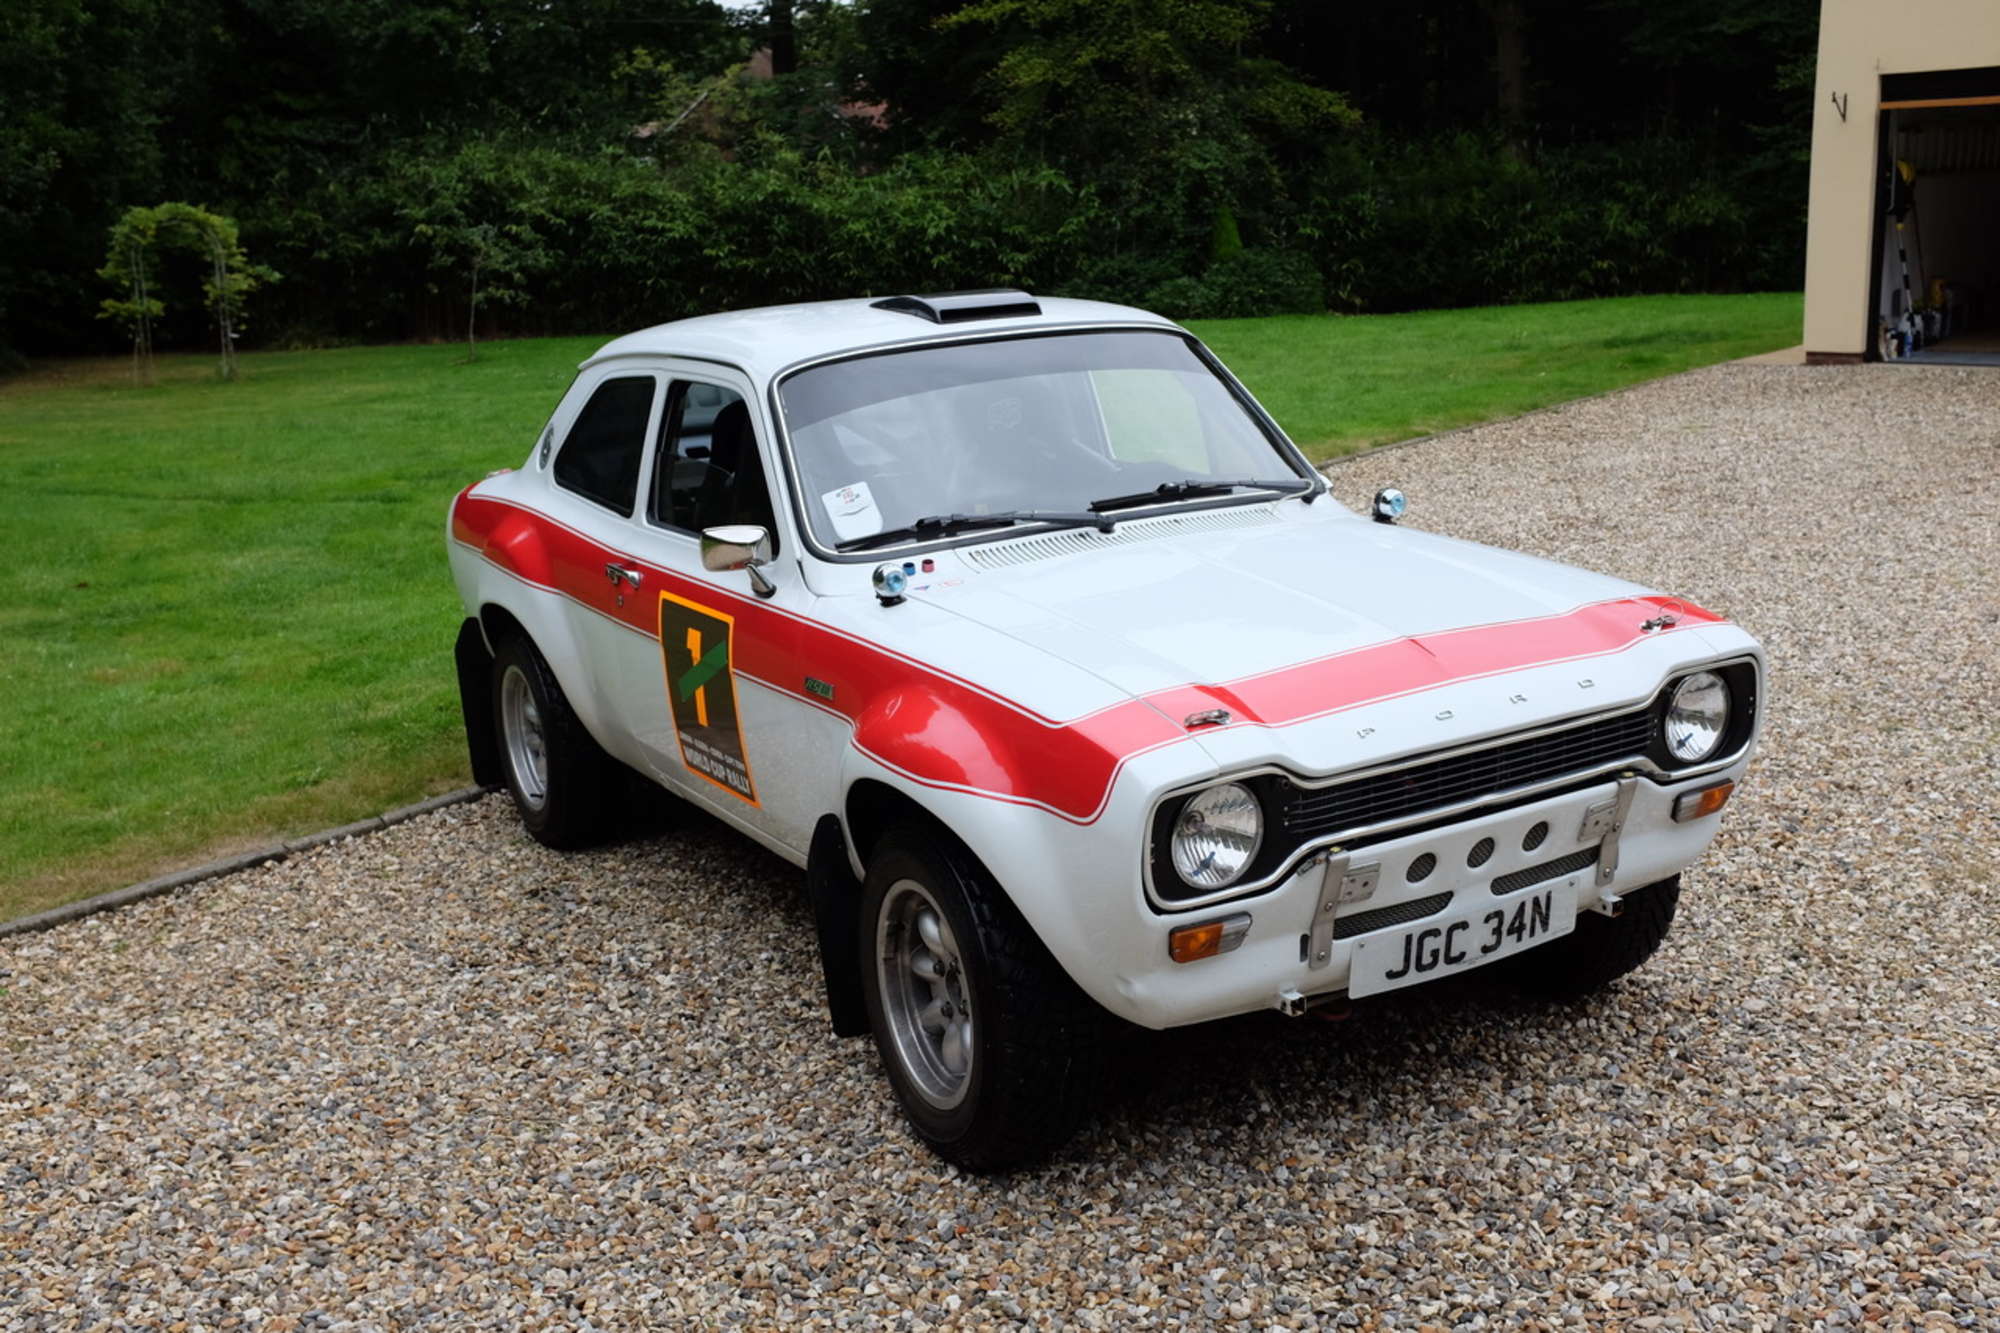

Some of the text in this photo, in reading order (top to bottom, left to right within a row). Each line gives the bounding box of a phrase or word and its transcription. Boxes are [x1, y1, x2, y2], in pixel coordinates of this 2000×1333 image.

[1356, 678, 1595, 739] FORD
[1385, 890, 1552, 980] JGC 34N
